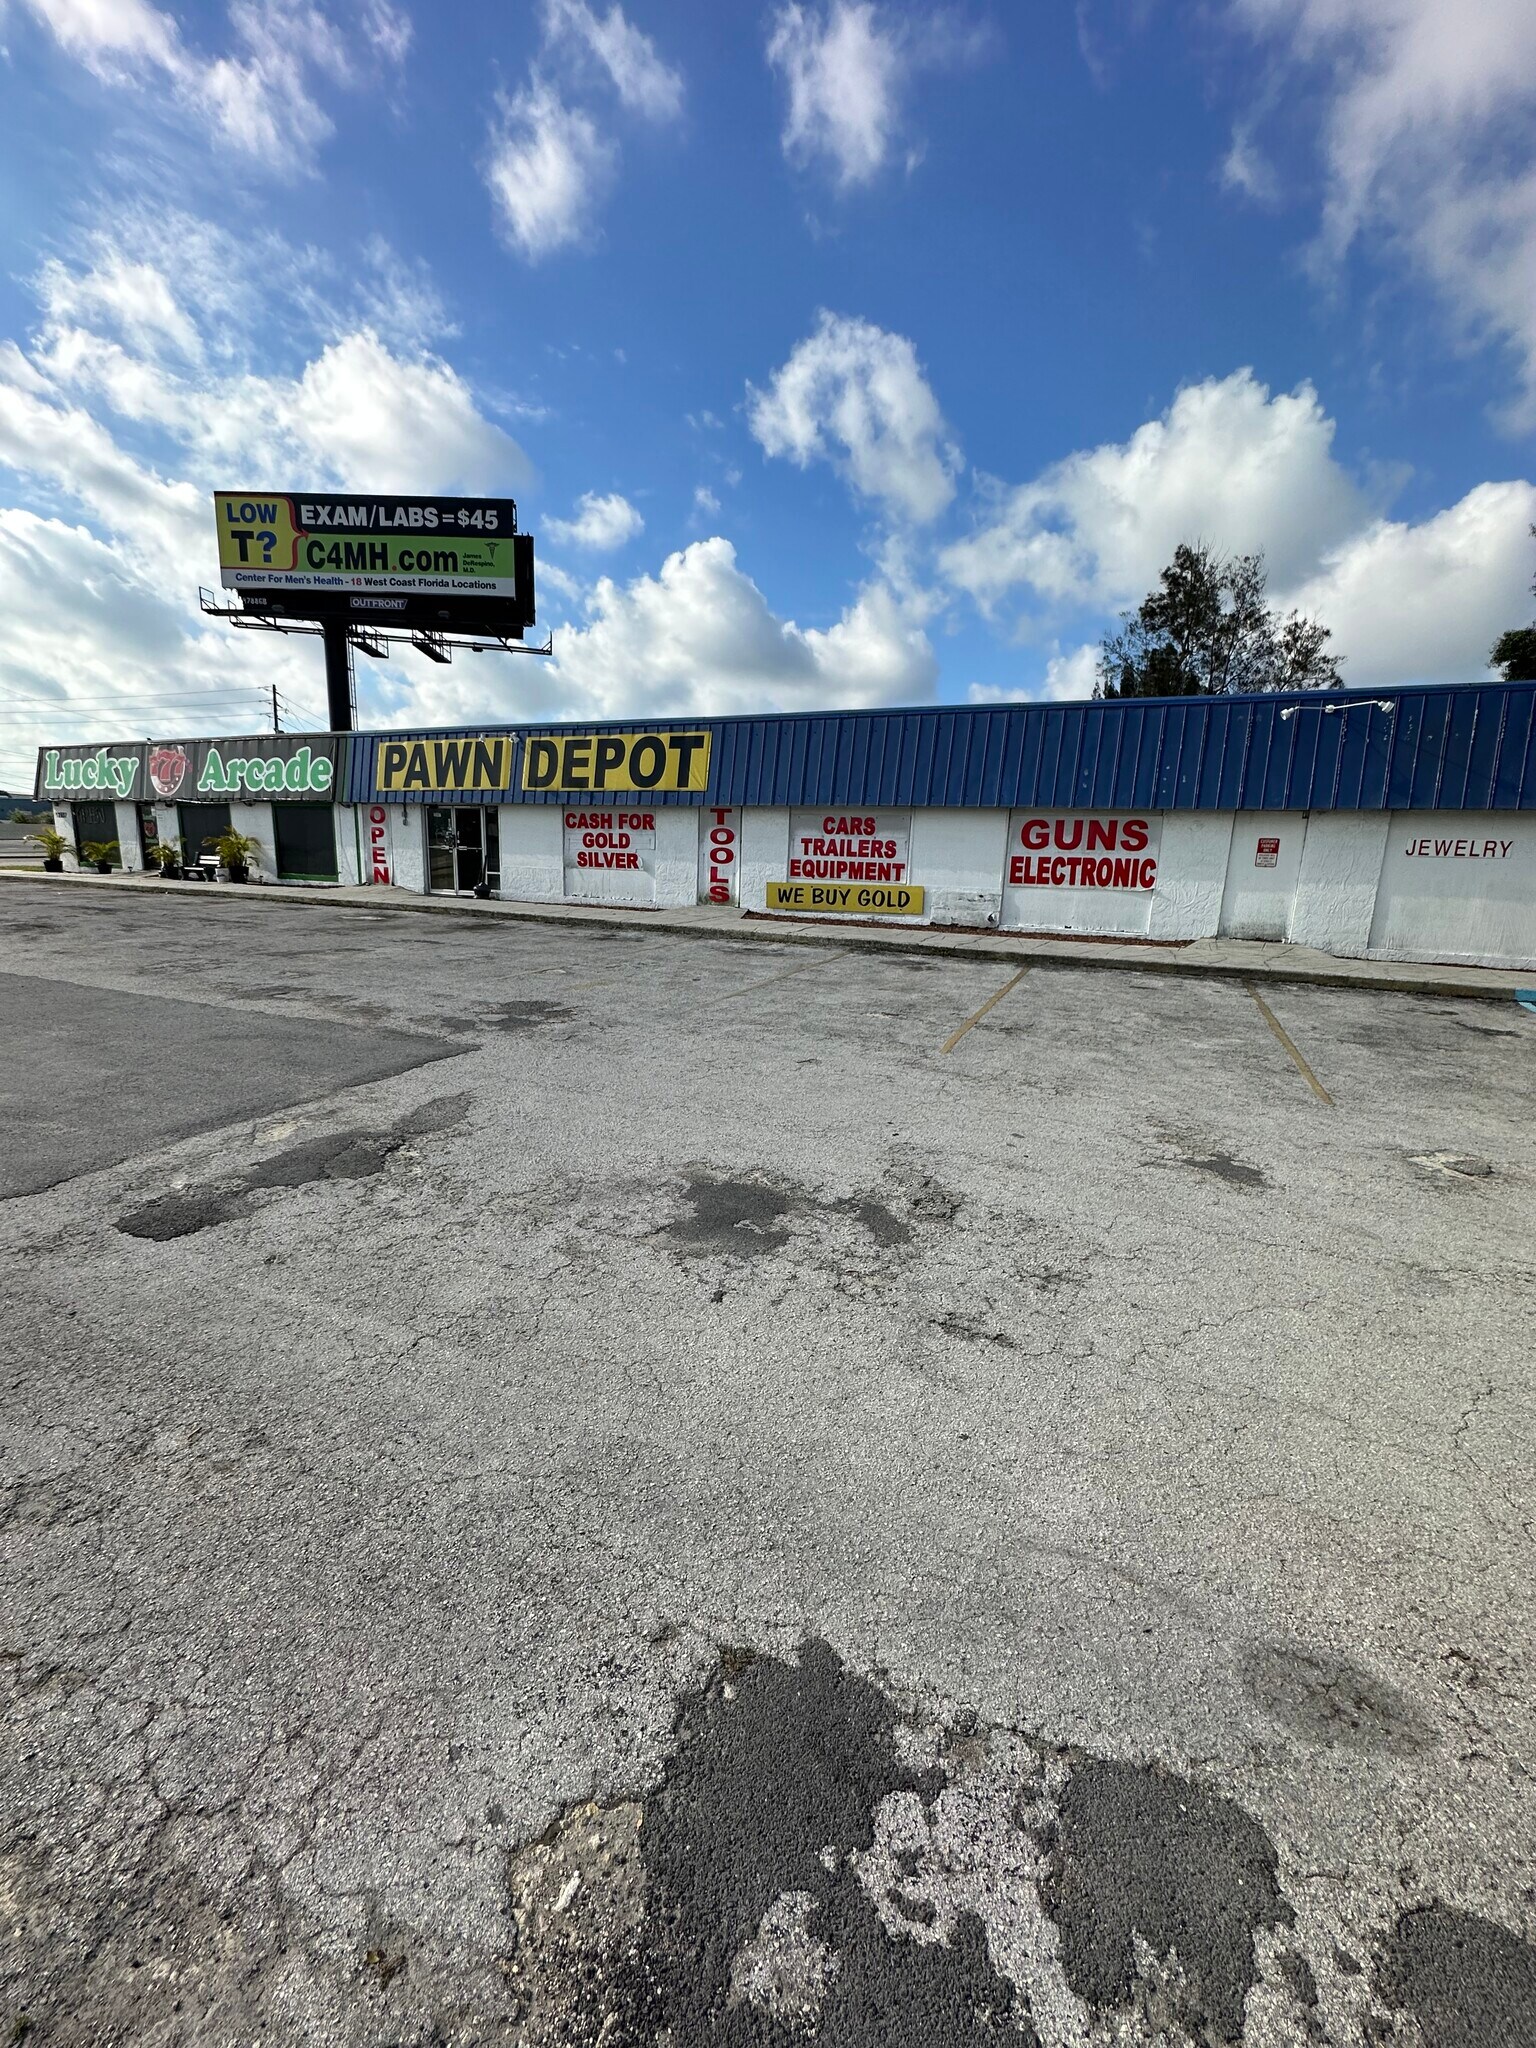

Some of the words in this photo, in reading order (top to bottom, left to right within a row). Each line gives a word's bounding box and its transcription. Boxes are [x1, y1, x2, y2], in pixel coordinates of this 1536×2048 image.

[226, 502, 278, 524] LOW
[231, 530, 278, 563] T?
[306, 540, 458, 572] C4MH.com
[235, 573, 266, 582] Center
[268, 574, 283, 583] For
[285, 575, 311, 584] Men's
[313, 577, 344, 586] Health
[364, 578, 387, 586] West
[389, 578, 416, 587] Coast
[418, 579, 450, 588] Florida
[452, 580, 497, 590] Locations
[352, 599, 405, 608] OUTFRONT
[45, 750, 139, 798] Lucky
[197, 746, 333, 792] Arcade
[383, 741, 503, 788] PAWN
[527, 735, 705, 788] DEPOT
[565, 813, 613, 829] CASH
[618, 814, 655, 830] FOR
[823, 816, 876, 836] CARS
[369, 806, 390, 884] OPEN
[582, 833, 631, 849] GOLD
[1021, 819, 1149, 851] GUNS
[709, 808, 735, 903] TOOLS
[801, 838, 897, 859] TRAILERS
[1405, 839, 1514, 858] JEWELRY
[577, 852, 639, 869] SILVER
[789, 859, 905, 882] EQUIPMENT
[1009, 856, 1157, 888] ELECTRONIC
[777, 888, 804, 904] WE
[812, 887, 851, 906] BUY
[857, 889, 911, 908] GOLD
